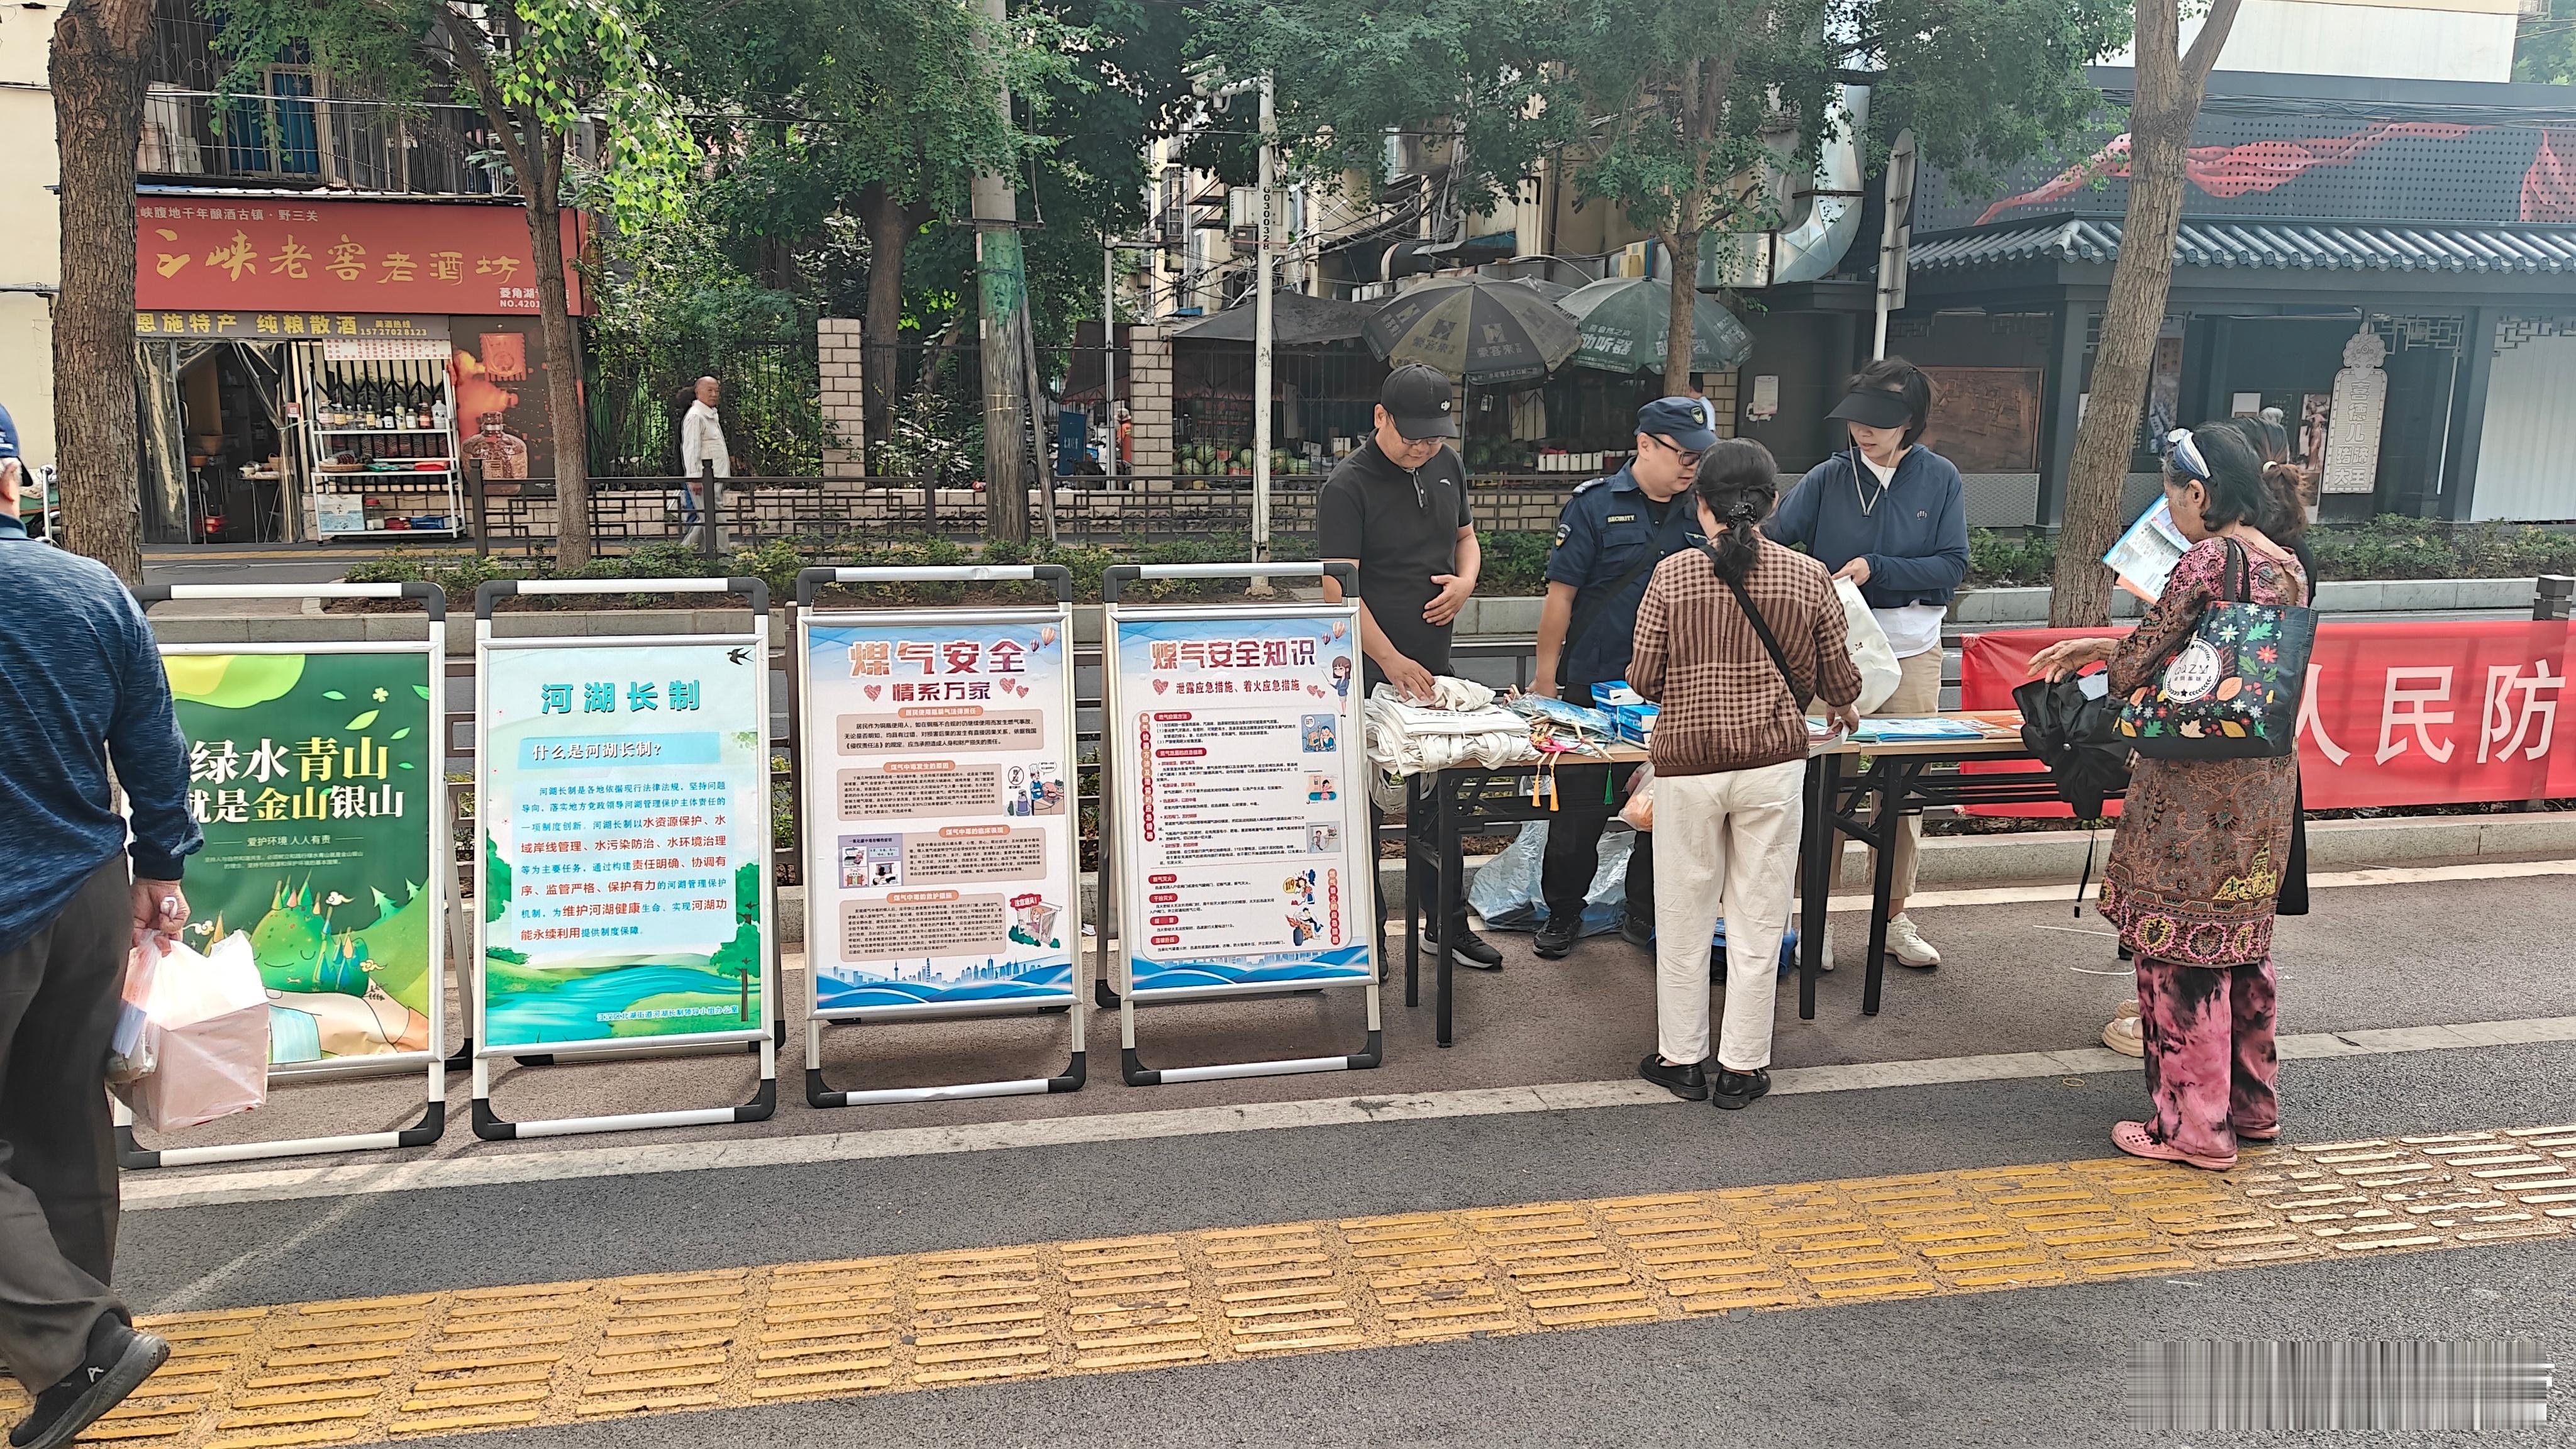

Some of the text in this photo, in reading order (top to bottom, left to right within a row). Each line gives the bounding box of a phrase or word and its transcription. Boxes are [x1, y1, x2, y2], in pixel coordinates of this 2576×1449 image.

[136, 206, 318, 221] 峡腹地千年酿酒古镇·野三关
[136, 313, 357, 335] 恩施特产 纯粮散酒
[2336, 446, 2369, 465] 猪蹄
[2333, 467, 2367, 485] 大王
[1607, 514, 1635, 523] SECURITY
[850, 640, 1025, 676] 煤气安全
[1152, 640, 1315, 670] 煤气安全知识
[892, 681, 991, 702] 情系万家
[1175, 679, 1301, 694] 泄露应急措施、着火应急措施
[541, 679, 700, 715] 河湖长制
[189, 736, 389, 784] 绿水青山
[247, 835, 331, 847] 爱护环境 人人有责
[521, 835, 727, 853] 域岸线管理、水污染防治、水环境治理
[1285, 879, 1295, 891] 119
